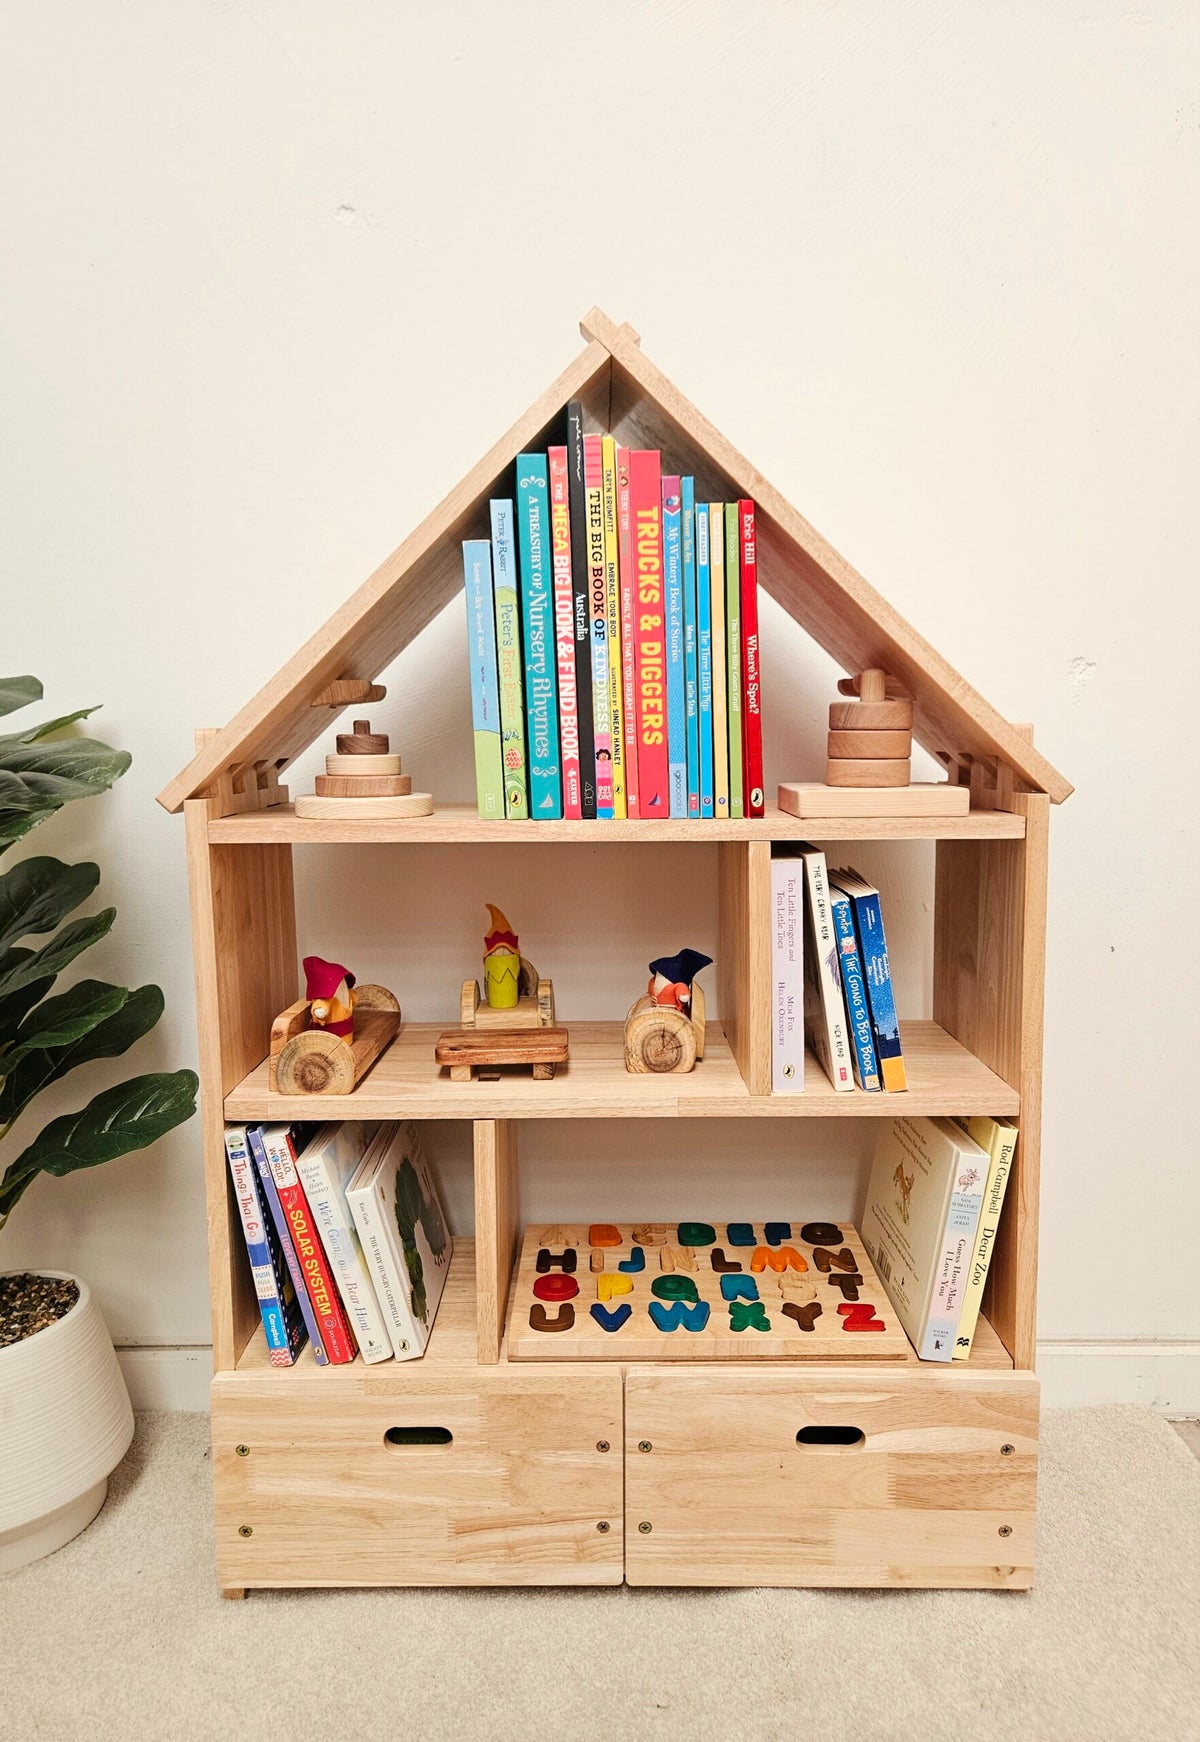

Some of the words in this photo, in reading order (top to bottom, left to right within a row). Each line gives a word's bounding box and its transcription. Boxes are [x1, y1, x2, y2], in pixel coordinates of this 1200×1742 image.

[555, 482, 563, 501] THE
[605, 469, 613, 492] TARYN
[529, 496, 539, 504] A
[590, 491, 602, 527] THE
[530, 506, 541, 570] TREASURY
[554, 504, 567, 552] MEGA
[668, 526, 678, 541] My
[744, 514, 754, 540] Eric
[591, 533, 603, 562] BIG
[637, 506, 660, 604] TRUCKS
[745, 542, 755, 565] Hill
[555, 555, 571, 585] BIG
[668, 543, 680, 585] Wintery
[532, 573, 543, 589] OF
[592, 567, 605, 614] BOOK
[608, 562, 616, 597] EMBRACE
[670, 587, 680, 614] Book
[501, 603, 514, 646] Peter's
[555, 590, 573, 639] LOOK
[575, 592, 588, 640] Australia
[640, 614, 662, 632] &
[670, 616, 680, 625] of
[527, 591, 547, 673] Nursery
[595, 619, 605, 640] OF
[609, 620, 617, 638] BODY
[624, 623, 632, 639] ALL
[701, 629, 710, 644] The
[557, 641, 575, 658] &
[624, 641, 632, 661] THAT
[670, 629, 681, 663] Stories
[731, 634, 739, 653] Three
[701, 647, 711, 670] Three
[746, 634, 758, 680] Where's
[625, 664, 633, 680] YOU
[702, 671, 712, 693] Little
[732, 671, 740, 692] Goats
[558, 662, 577, 711] FIND
[595, 644, 608, 732] KINDNESS
[640, 641, 663, 745] DIGGERS
[747, 683, 759, 714] Spot?
[700, 695, 712, 711] Pigs
[732, 693, 740, 711] Gruff
[529, 678, 552, 758] Rhymes
[627, 712, 634, 721] IT
[627, 722, 634, 733] TO
[561, 715, 580, 761] BOOK
[627, 735, 635, 745] BE
[570, 778, 578, 805] CLEVER
[813, 865, 822, 878] THE
[787, 877, 796, 893] Ten
[814, 880, 823, 896] VERY
[776, 891, 785, 906] Ten
[788, 895, 796, 916] Little
[777, 908, 786, 929] Little
[836, 904, 852, 934] Boynton
[777, 931, 786, 949] Toes
[786, 918, 796, 947] Fingers
[845, 955, 859, 972] THE
[848, 974, 863, 1006] GOING
[854, 1008, 866, 1020] TO
[856, 1020, 871, 1045] BED
[860, 1045, 874, 1075] BOOK
[999, 1144, 1013, 1164] Rod
[234, 1159, 247, 1193] Things
[988, 1166, 1007, 1215] Campbell
[241, 1193, 254, 1219] That
[247, 1222, 259, 1238] Go
[369, 1235, 378, 1248] THE
[678, 1222, 716, 1246] D
[765, 1222, 792, 1246] F
[282, 1238, 293, 1256] LOVE
[954, 1238, 967, 1263] Guess
[978, 1227, 995, 1260] Dear
[287, 1257, 297, 1267] MY
[290, 1210, 314, 1256] SOLAR
[305, 1259, 332, 1316] SYSTEM
[318, 1201, 333, 1226] We're
[345, 1282, 361, 1304] Bear
[354, 1307, 371, 1332] Hunt
[372, 1248, 384, 1264] VERY
[536, 1248, 578, 1273] H
[619, 1246, 645, 1272] J
[711, 1247, 743, 1272] L
[751, 1246, 808, 1272] M
[813, 1247, 859, 1273] N
[942, 1256, 953, 1277] Love
[292, 1268, 304, 1293] FAMILY
[377, 1265, 391, 1289] HUNGRY
[950, 1266, 961, 1285] How
[972, 1263, 987, 1286] Zoo
[533, 1273, 578, 1302] O
[597, 1273, 634, 1301] P
[652, 1273, 701, 1302] Q
[720, 1273, 760, 1301] R
[828, 1273, 864, 1301] T
[938, 1280, 949, 1297] You
[945, 1287, 958, 1311] Much
[385, 1290, 402, 1328] CATERPILLAR
[530, 1303, 577, 1332] U
[590, 1303, 633, 1332] V
[649, 1301, 711, 1332] W
[729, 1301, 771, 1332] X
[782, 1302, 823, 1332] Y
[837, 1303, 886, 1332] Z
[268, 1313, 280, 1346] Campbell
